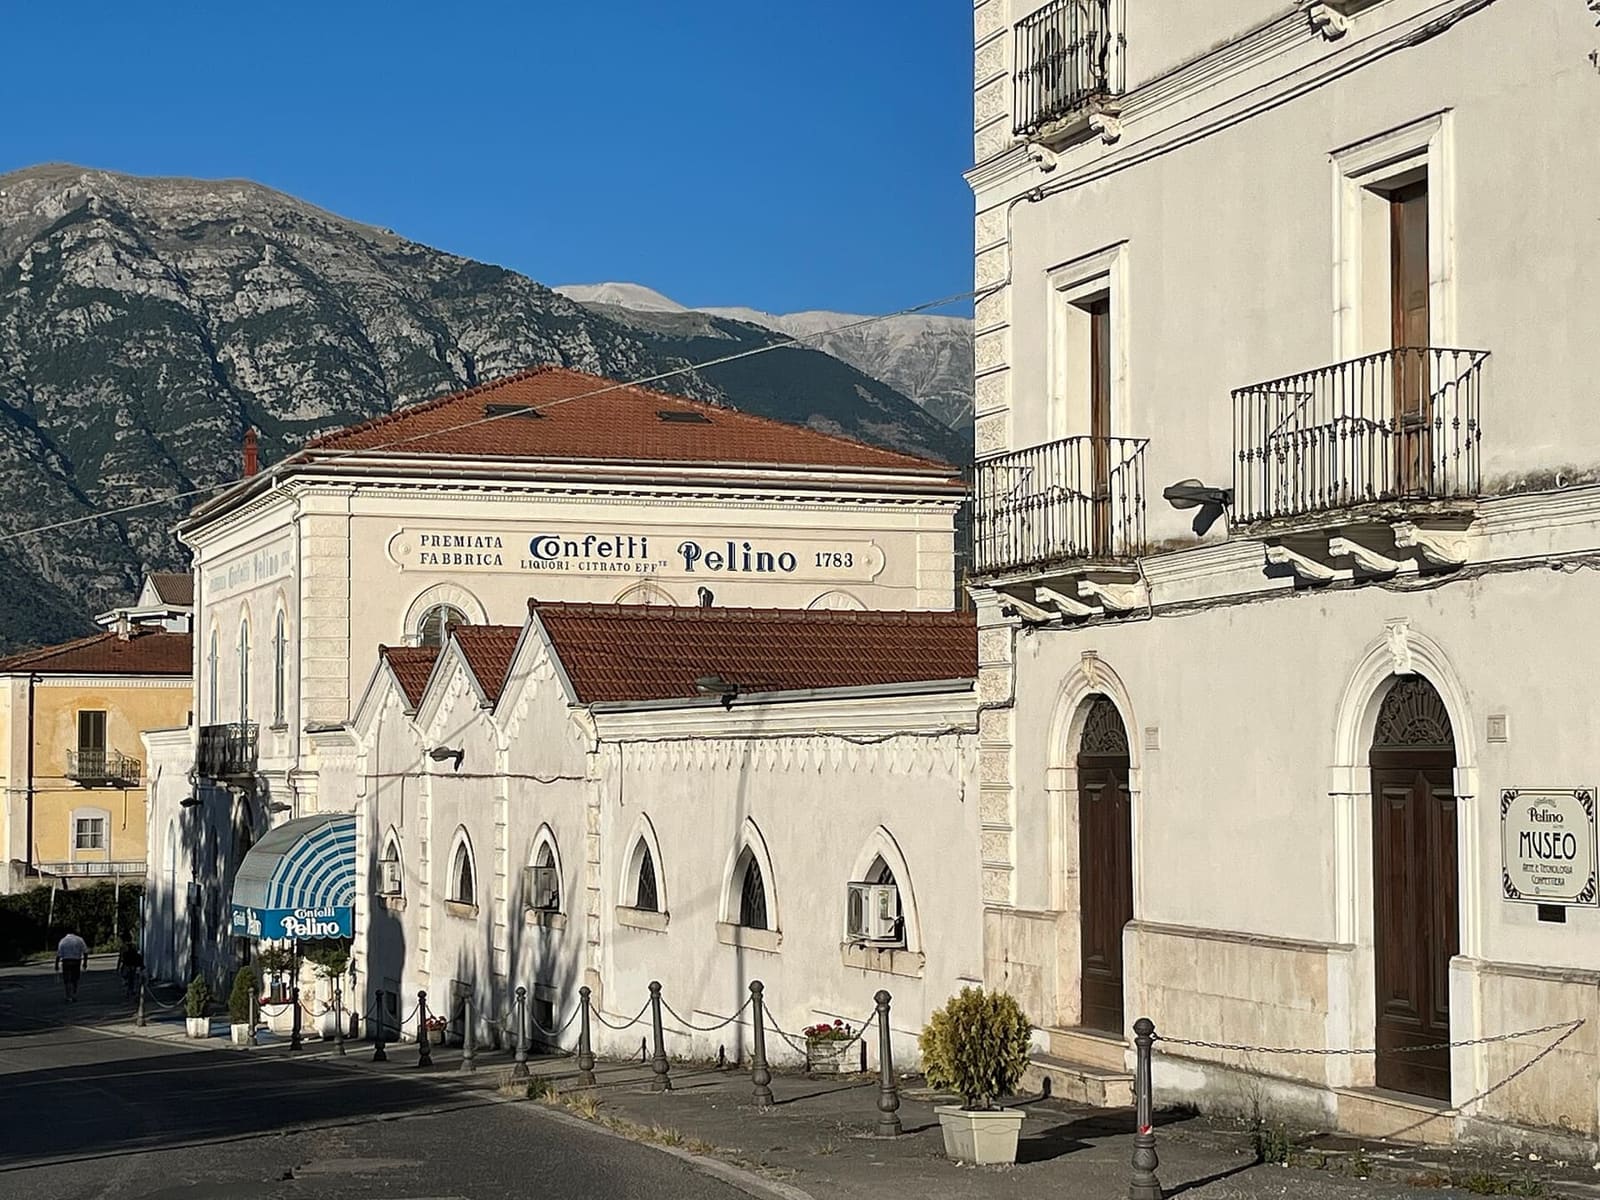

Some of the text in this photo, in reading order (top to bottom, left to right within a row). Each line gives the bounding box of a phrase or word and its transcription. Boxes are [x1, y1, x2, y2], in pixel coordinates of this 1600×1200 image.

[420, 535, 503, 548] PREMIATA
[420, 553, 503, 566] FABBRICA
[530, 535, 853, 573] Confetti Pelino 1783
[520, 560, 569, 571] LIQUORI
[578, 561, 631, 572] CITRATO
[1526, 806, 1564, 823] Pelino
[1519, 831, 1577, 860] MUSEO
[280, 916, 340, 937] Pelino
